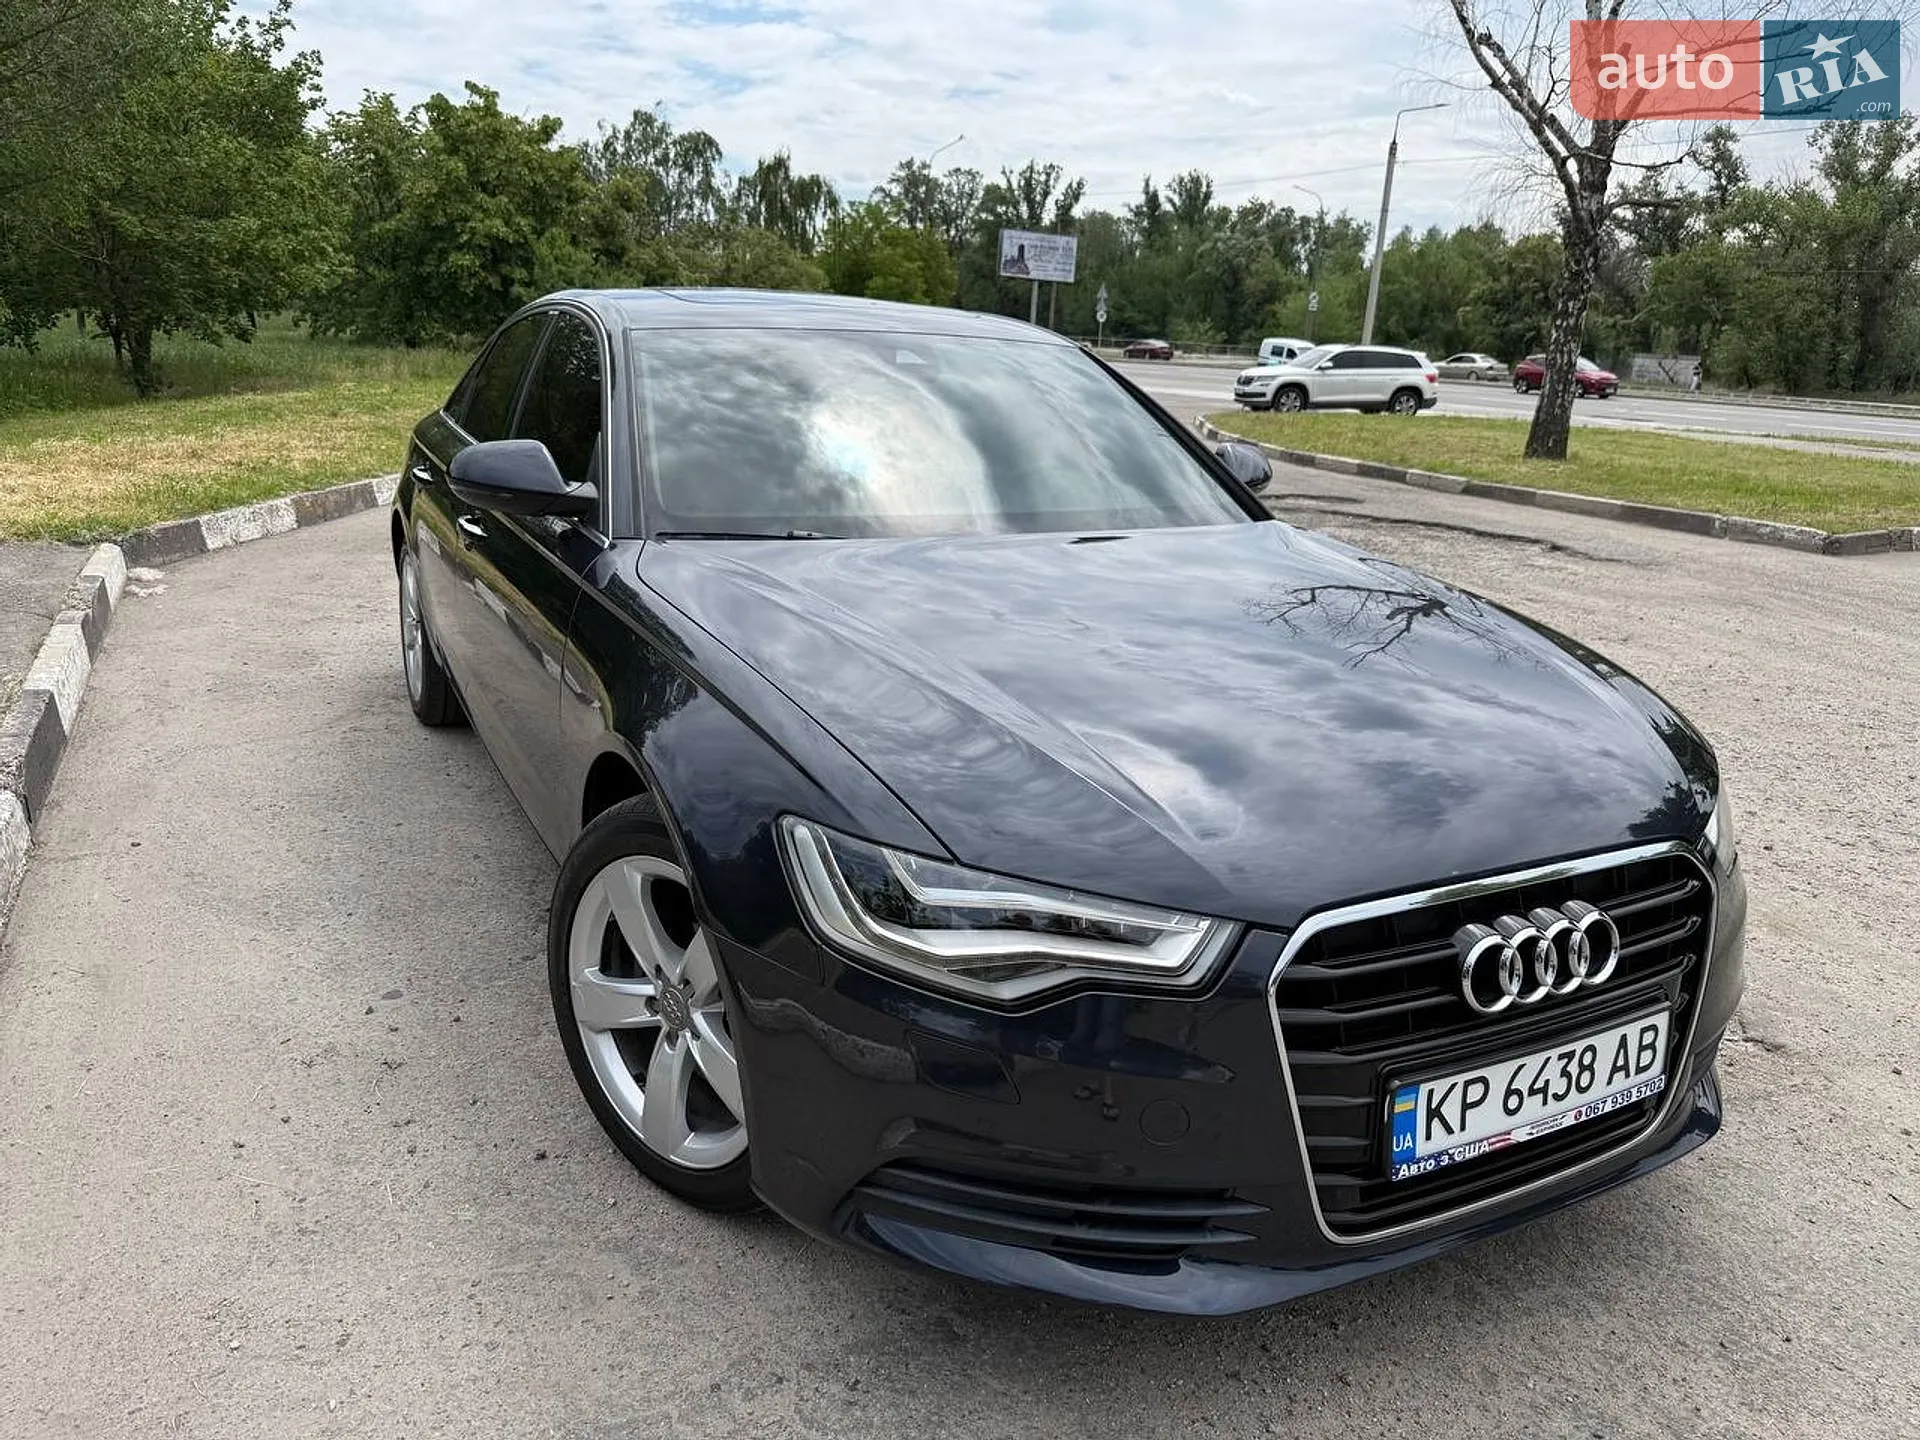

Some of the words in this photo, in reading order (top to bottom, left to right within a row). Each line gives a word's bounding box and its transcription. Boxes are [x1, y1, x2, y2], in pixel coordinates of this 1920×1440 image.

[1424, 1074, 1490, 1141] KP
[1502, 1043, 1597, 1117] 6438
[1606, 1023, 1659, 1086] AB
[1585, 1100, 1608, 1118] 067
[1610, 1090, 1633, 1108] 939
[1635, 1077, 1664, 1099] 5702
[1393, 1131, 1413, 1152] UA
[1454, 1140, 1490, 1161] США
